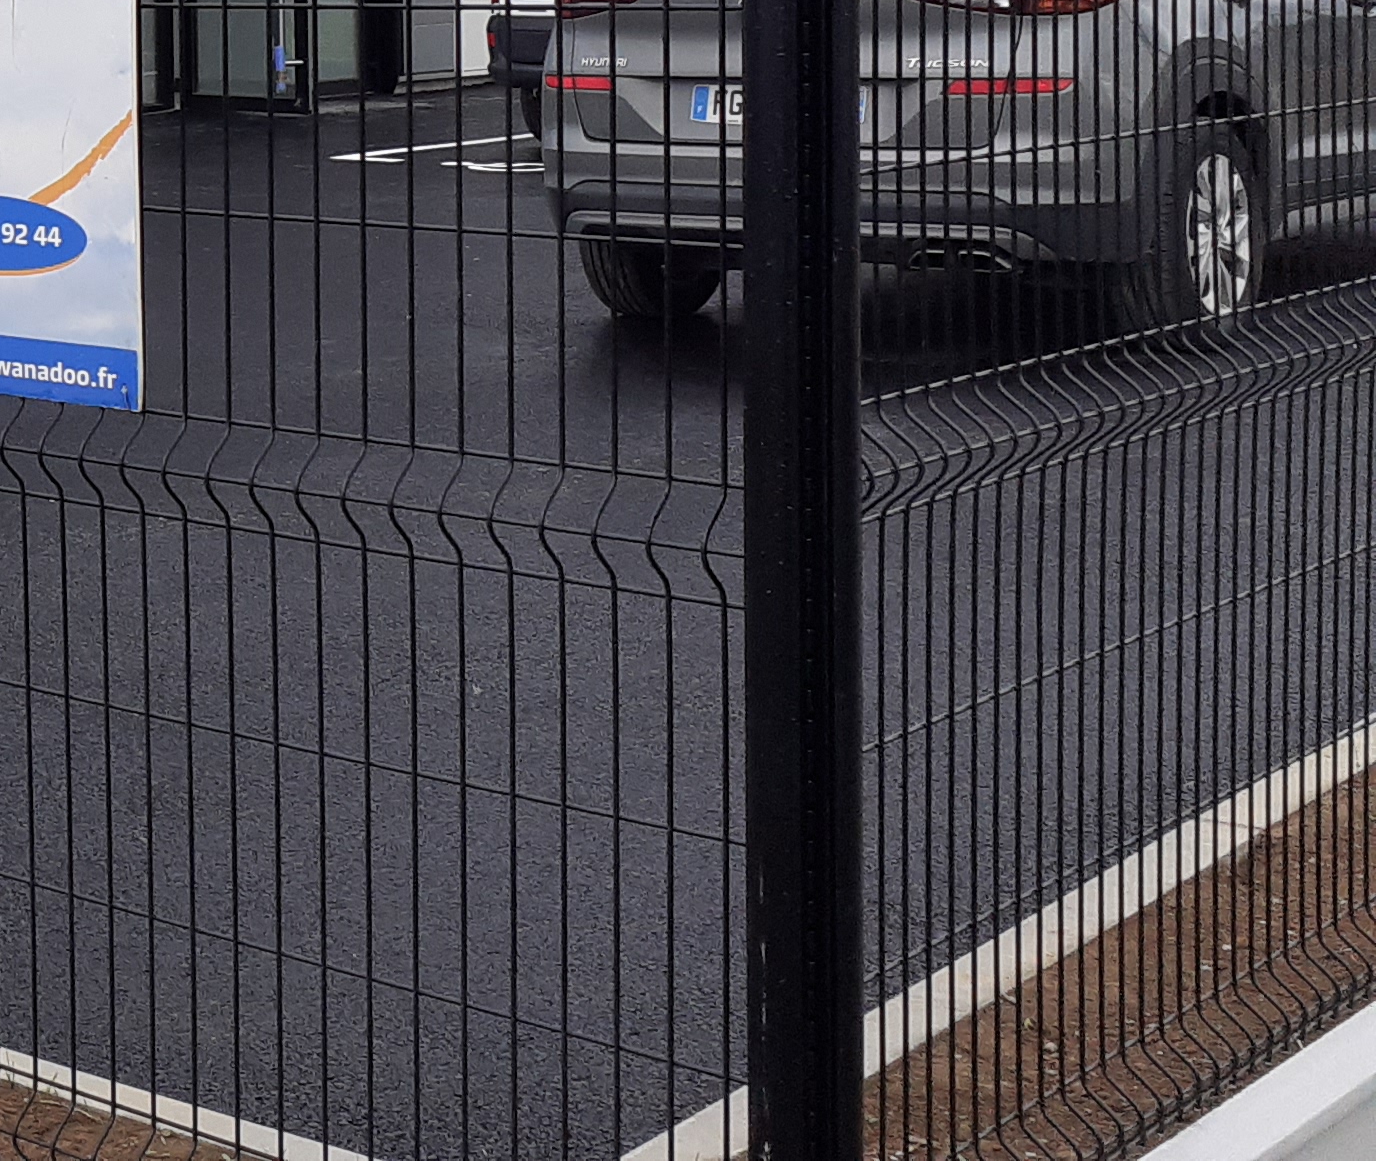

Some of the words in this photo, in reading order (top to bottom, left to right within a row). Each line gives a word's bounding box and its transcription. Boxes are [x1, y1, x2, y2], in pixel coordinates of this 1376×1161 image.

[581, 57, 627, 67] HYUNAI
[1, 223, 28, 245] 92
[33, 225, 63, 248] 44
